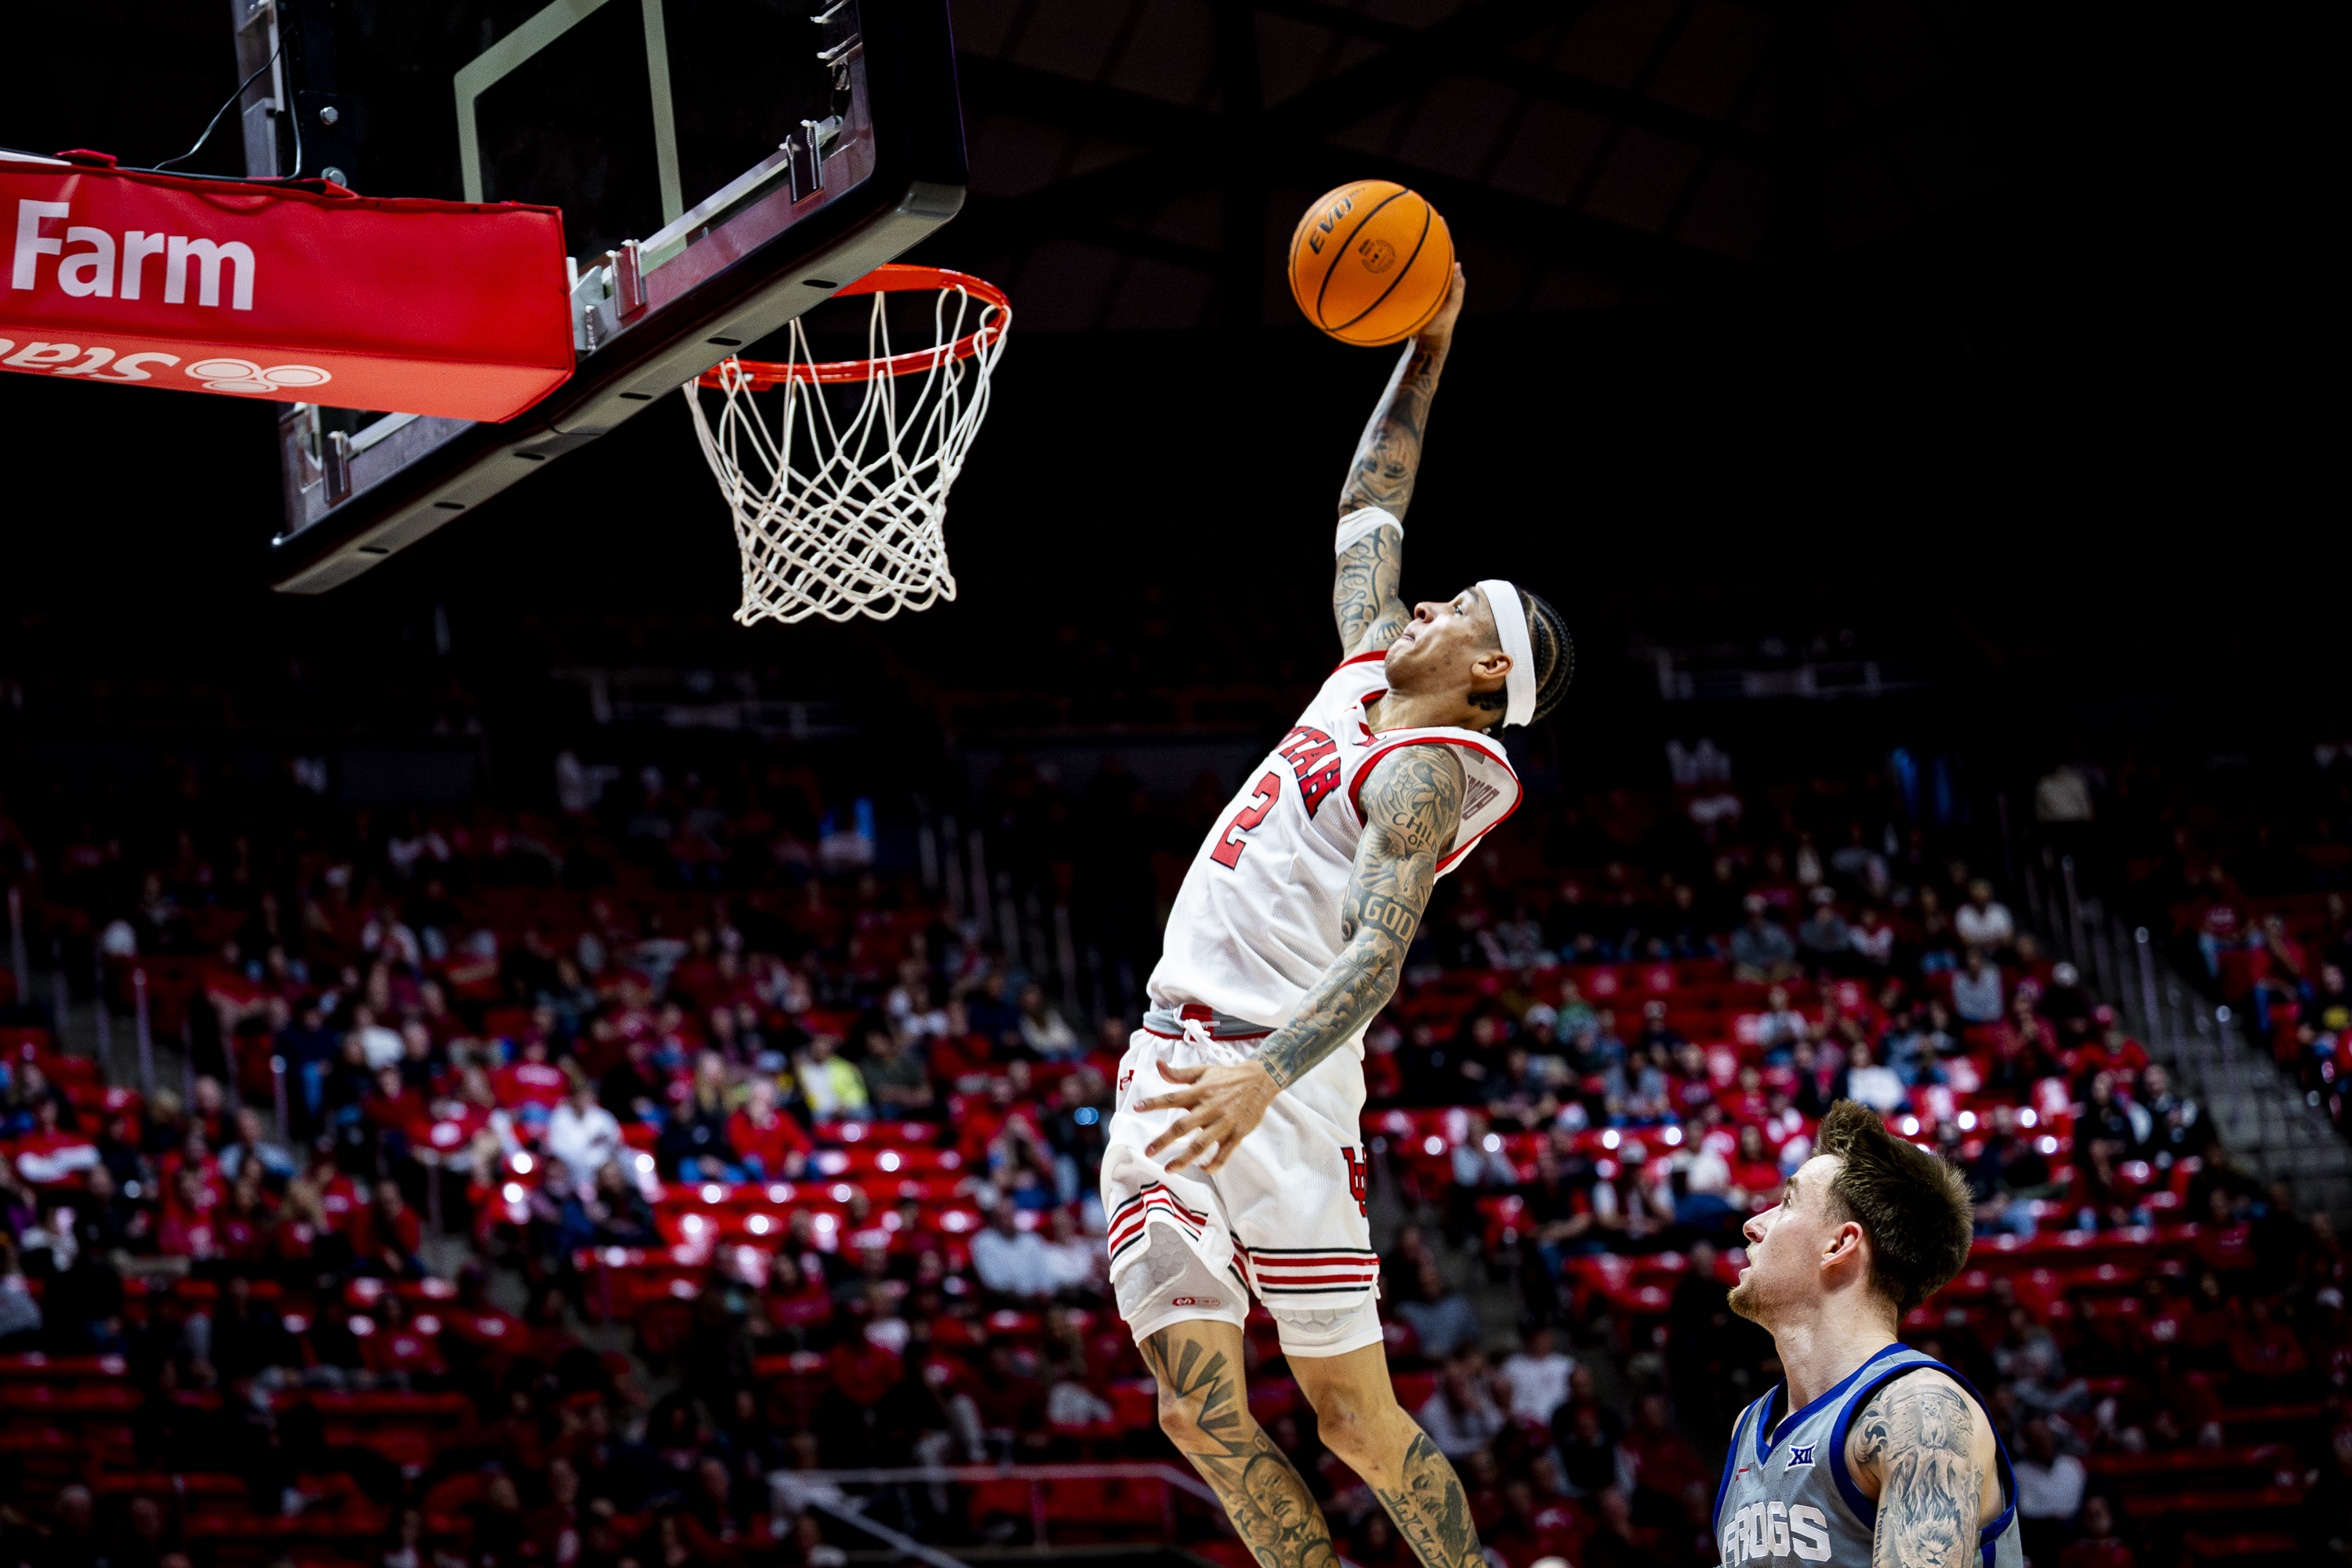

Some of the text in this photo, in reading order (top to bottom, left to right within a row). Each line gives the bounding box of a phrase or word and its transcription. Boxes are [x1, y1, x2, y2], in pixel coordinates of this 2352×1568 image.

[1309, 197, 1354, 255] EVO
[12, 199, 256, 311] Farm
[1210, 771, 1281, 871] 2
[1392, 811, 1438, 854] CHILD
[1407, 833, 1425, 849] OF
[1363, 895, 1416, 939] GOD
[1788, 1443, 1817, 1468] XII
[1722, 1501, 1832, 1568] FROGS
